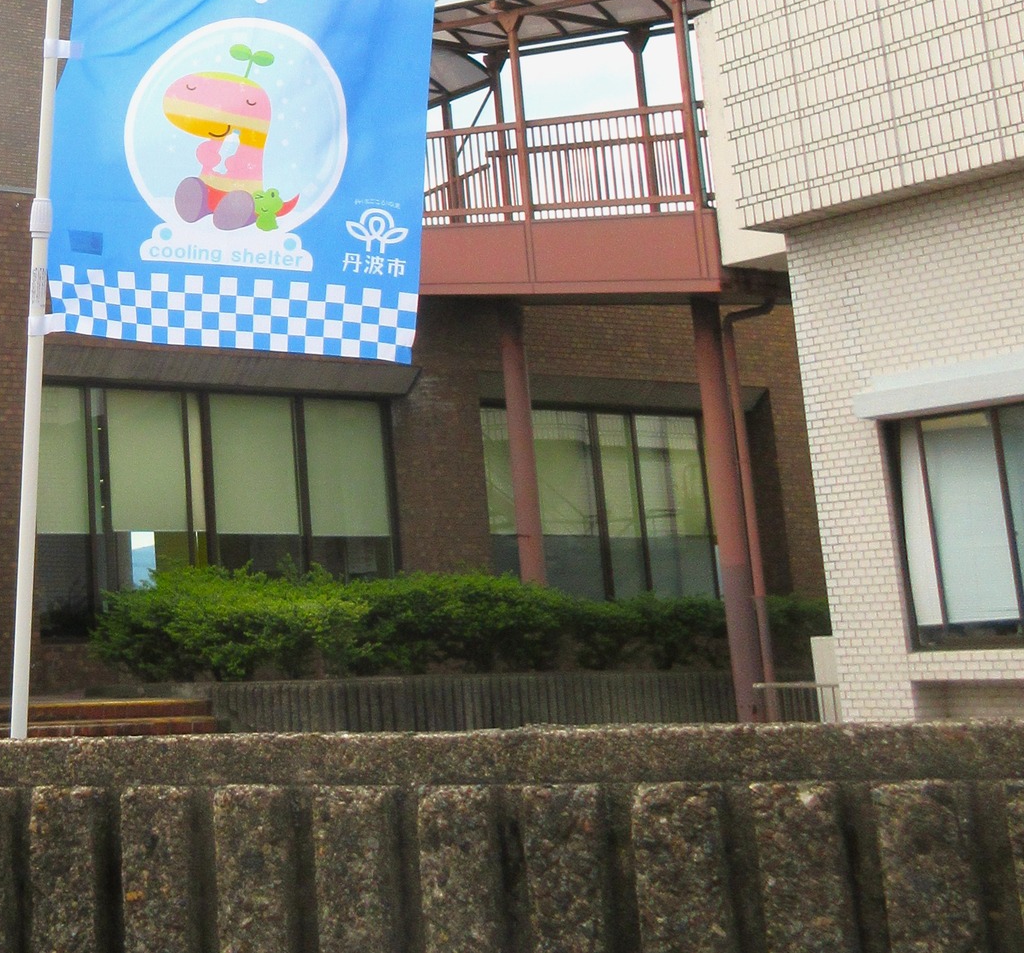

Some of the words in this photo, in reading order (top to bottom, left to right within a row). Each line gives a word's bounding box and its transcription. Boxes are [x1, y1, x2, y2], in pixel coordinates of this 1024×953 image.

[149, 245, 222, 263] cooling
[231, 249, 303, 267] shelter
[342, 252, 407, 278] 丹波市
